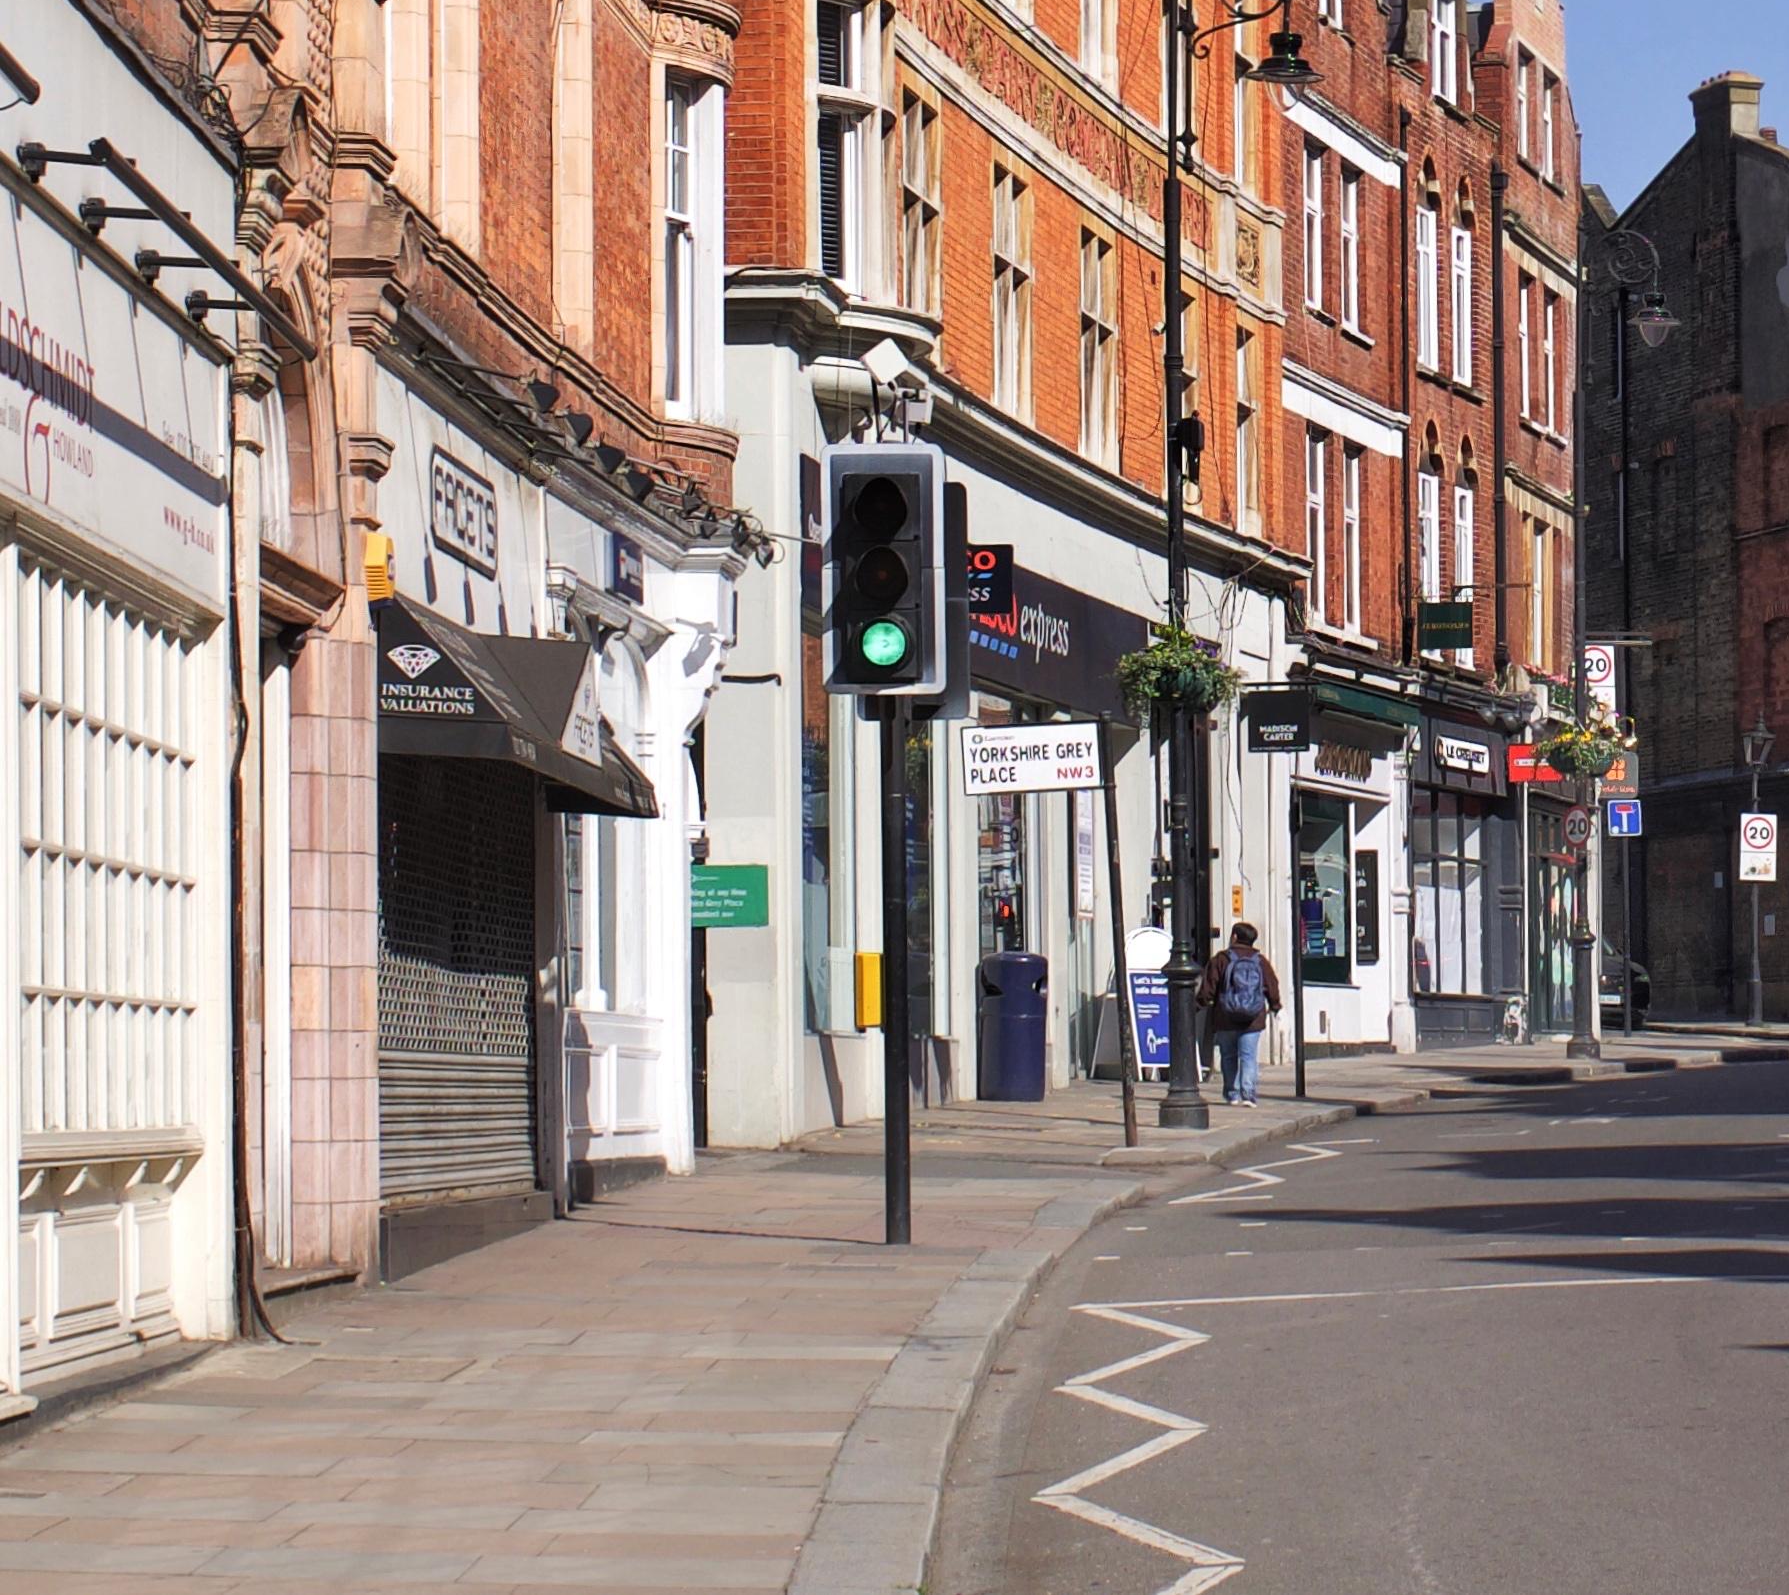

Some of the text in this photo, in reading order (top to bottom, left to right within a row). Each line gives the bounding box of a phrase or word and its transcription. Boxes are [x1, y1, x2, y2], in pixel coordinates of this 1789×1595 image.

[53, 426, 94, 478] HOWLAND
[433, 464, 496, 559] FACETS
[1020, 603, 1069, 664] express
[1584, 659, 1607, 672] 20
[382, 684, 474, 700] INSURANCE
[380, 698, 475, 715] VALUATIONS
[1264, 733, 1294, 741] CARTER
[970, 742, 1093, 763] YORKSHIRE GREY
[1446, 745, 1455, 758] LE
[971, 767, 1017, 784] PLACE
[1568, 818, 1588, 835] 20
[1749, 826, 1770, 840] 20
